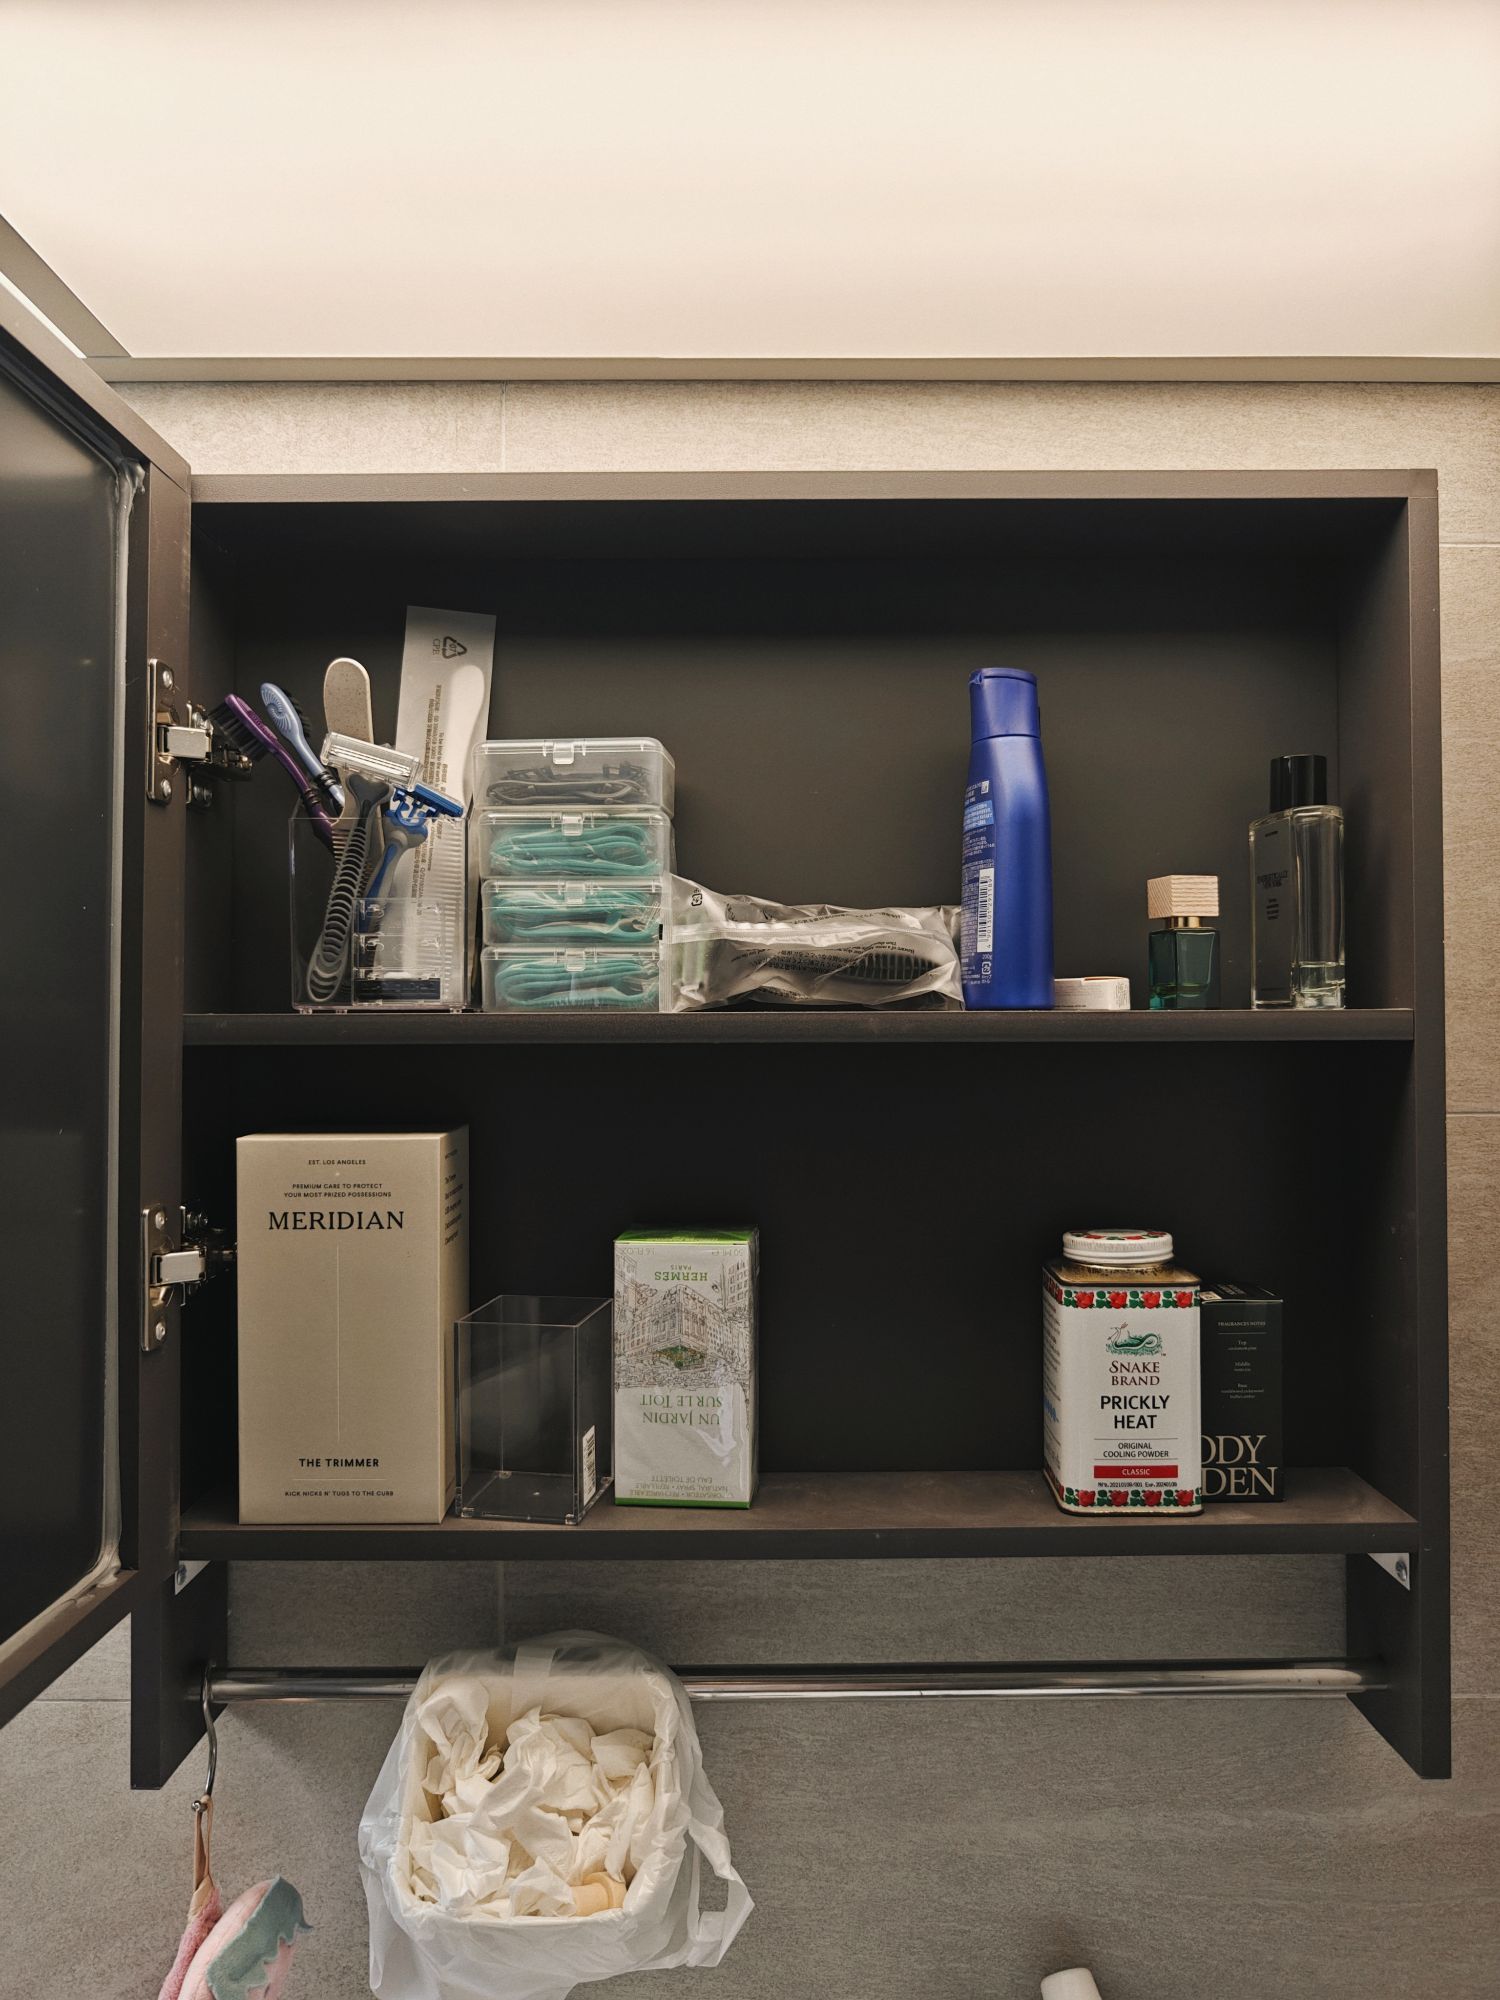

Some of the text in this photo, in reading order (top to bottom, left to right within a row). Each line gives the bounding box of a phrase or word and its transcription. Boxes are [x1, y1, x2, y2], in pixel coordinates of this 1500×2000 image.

[432, 638, 441, 655] CPE
[269, 1211, 404, 1230] MERIDIAN
[1109, 1360, 1160, 1373] SNAKE
[1112, 1376, 1160, 1385] BRAND
[639, 1394, 722, 1408] SUR LE TOIT
[1101, 1395, 1170, 1409] PRICKLY
[642, 1411, 720, 1426] UN JARDIN
[1114, 1415, 1157, 1429] HEAT
[298, 1458, 379, 1467] THE TRIMMER
